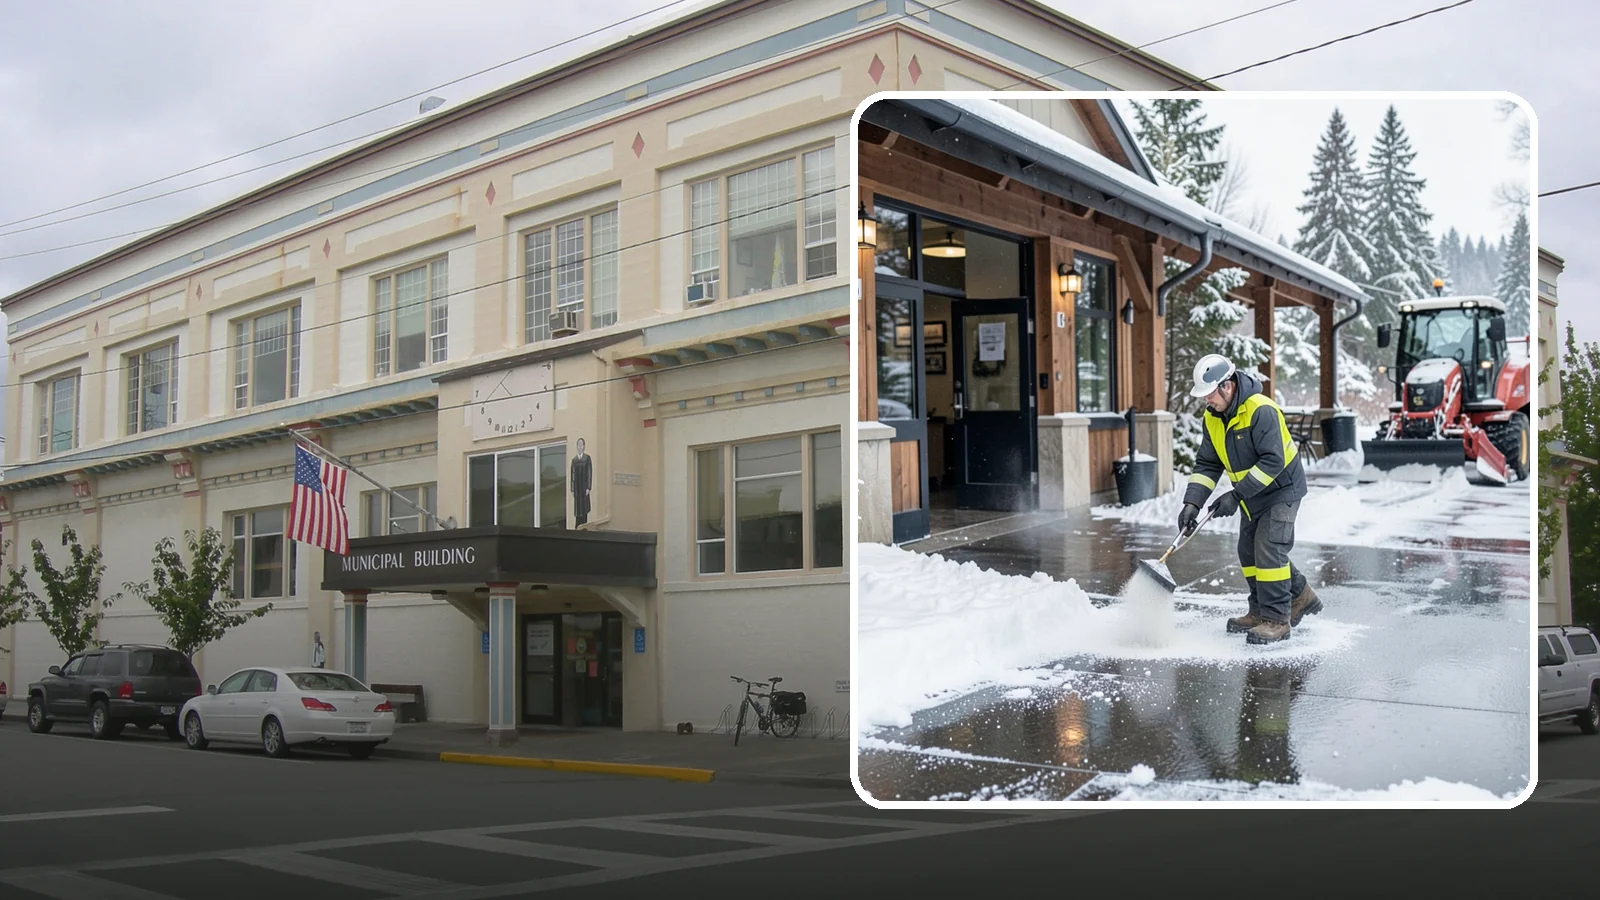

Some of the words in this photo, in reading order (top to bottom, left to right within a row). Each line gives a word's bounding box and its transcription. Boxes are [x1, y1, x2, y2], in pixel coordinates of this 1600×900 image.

[487, 417, 493, 426] 9
[520, 420, 526, 428] 2
[494, 424, 500, 432] 10
[507, 425, 513, 433] 12
[342, 553, 405, 571] MUNICIPAL
[414, 547, 475, 566] BUILDING
